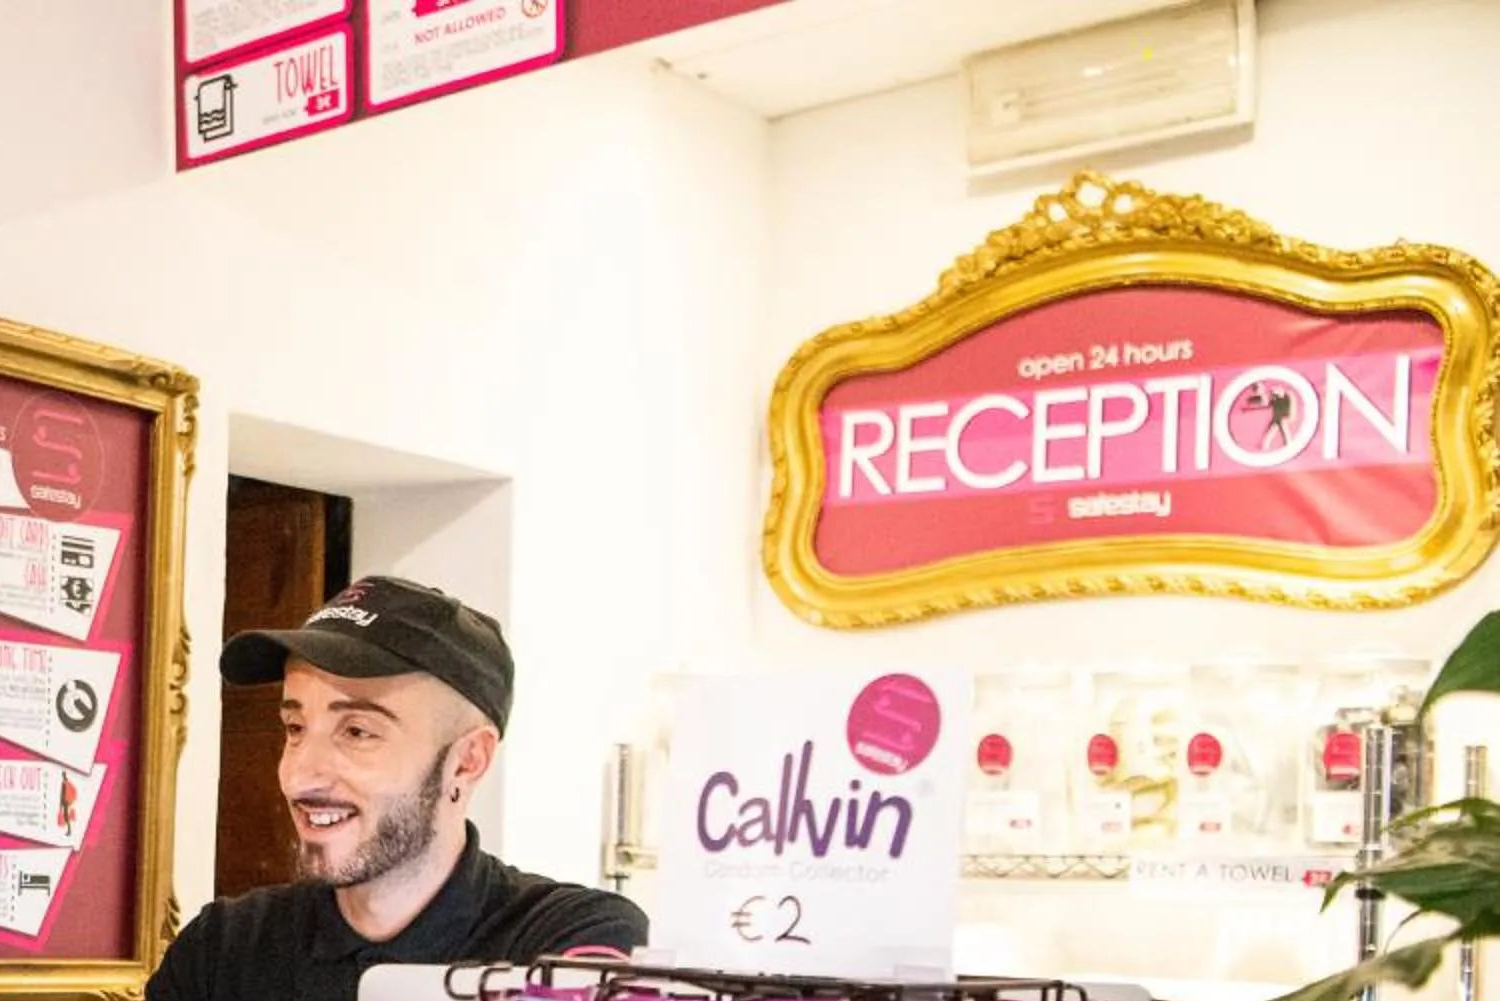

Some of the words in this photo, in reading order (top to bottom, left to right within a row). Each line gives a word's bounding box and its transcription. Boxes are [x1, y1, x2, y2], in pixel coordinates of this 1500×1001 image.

[414, 27, 440, 45] NOT
[443, 7, 507, 36] ALLOWED
[273, 44, 339, 102] TOWEL
[1017, 348, 1085, 380] open
[1090, 344, 1119, 370] 24
[1123, 337, 1194, 365] hours
[838, 354, 1411, 498] RECEPTION
[1067, 489, 1171, 520] safestay
[21, 767, 43, 792] OUT
[697, 740, 913, 858] Callvin
[1219, 862, 1293, 883] TOWEL
[731, 895, 813, 944] €2
